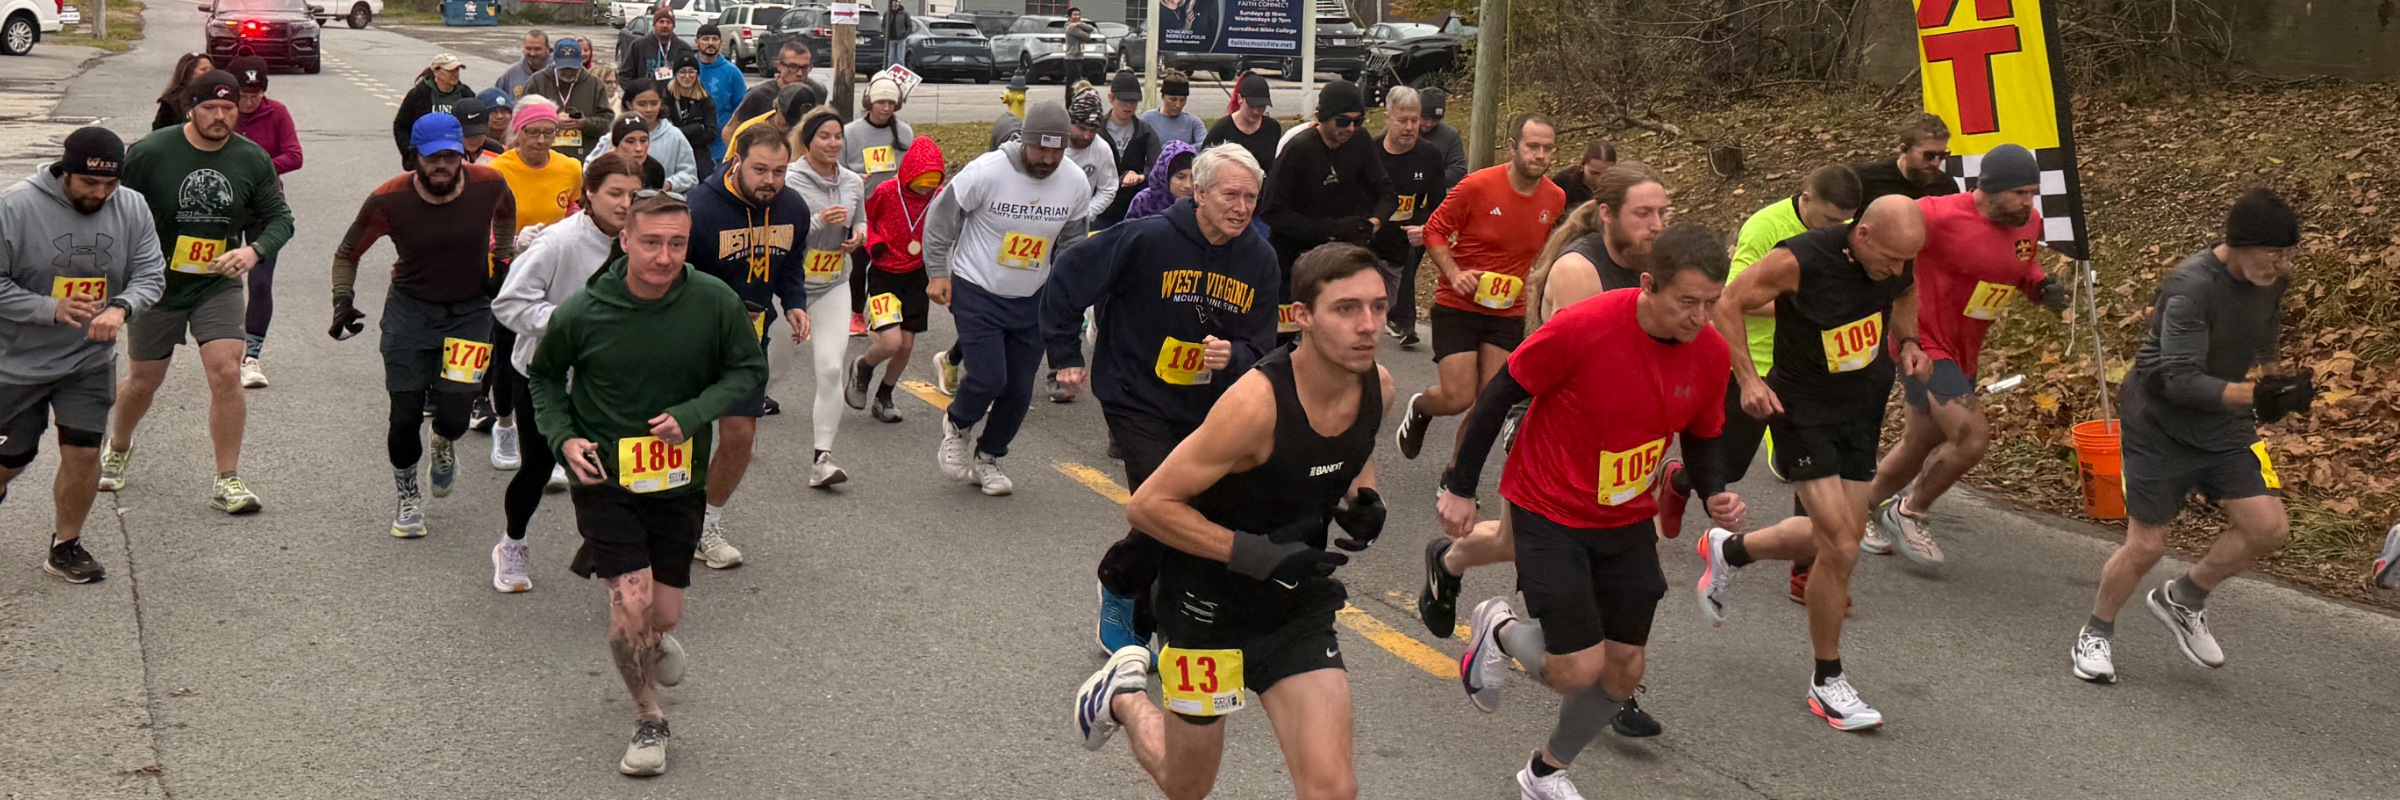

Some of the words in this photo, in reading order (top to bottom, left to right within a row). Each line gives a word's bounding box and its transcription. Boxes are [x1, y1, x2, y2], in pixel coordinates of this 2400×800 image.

[872, 148, 887, 163] 47
[989, 200, 1069, 216] LIBERTARIAN
[188, 241, 216, 263] 83
[1008, 235, 1043, 259] 124
[810, 253, 841, 272] 127
[1161, 269, 1202, 299] WEST
[1205, 271, 1255, 315] VIRGINIA
[1490, 276, 1513, 298] 84
[1983, 287, 2008, 308] 77
[872, 295, 890, 316] 97
[1834, 319, 1878, 358] 109
[449, 342, 488, 370] 170
[1168, 345, 1206, 372] 18
[631, 439, 683, 474] 186
[1613, 445, 1659, 487] 105
[1315, 461, 1345, 476] BANDIT
[1175, 655, 1218, 694] 13
